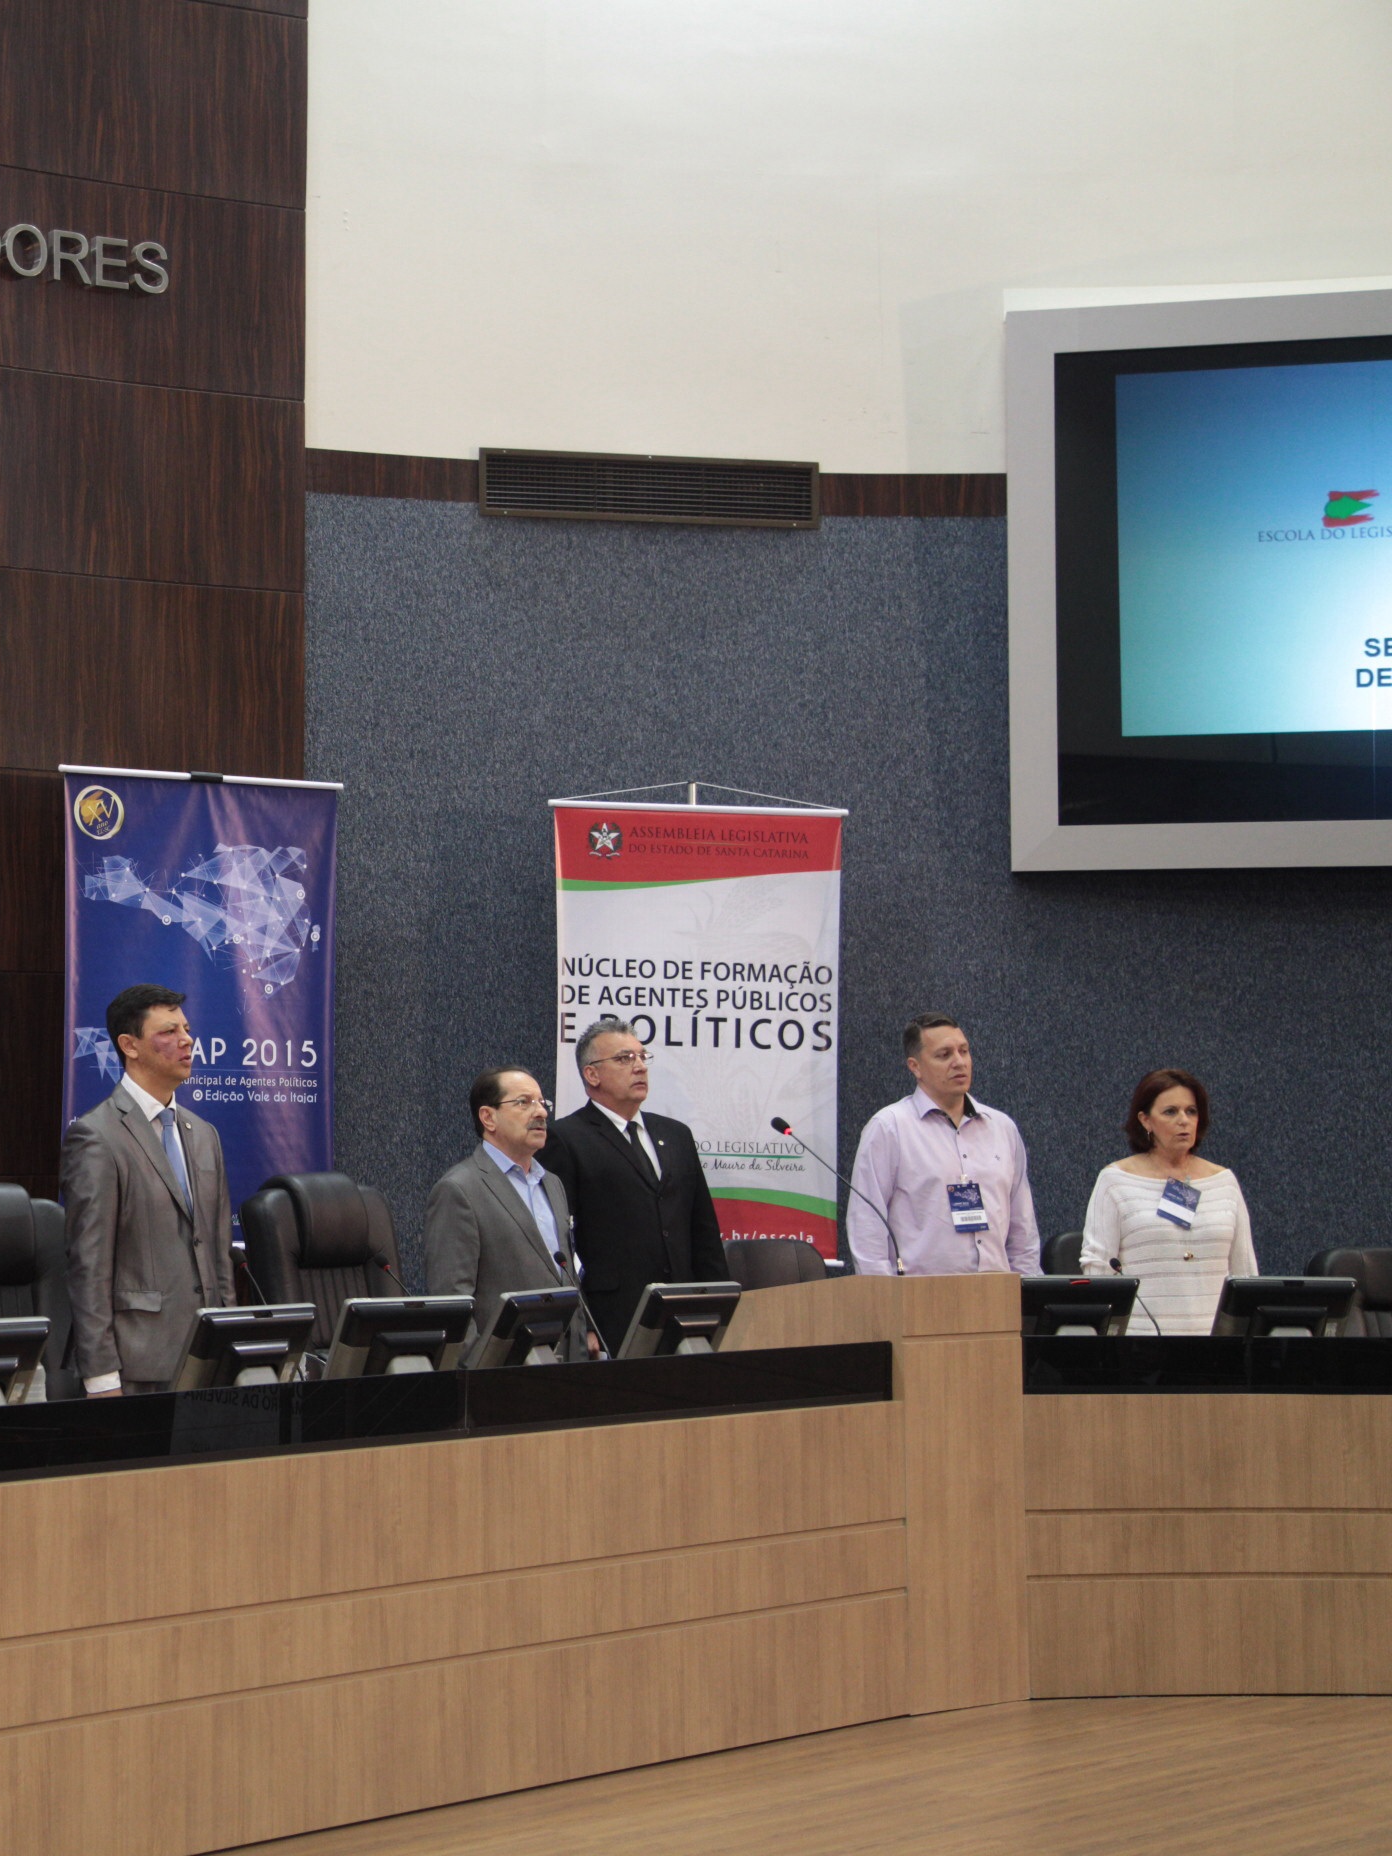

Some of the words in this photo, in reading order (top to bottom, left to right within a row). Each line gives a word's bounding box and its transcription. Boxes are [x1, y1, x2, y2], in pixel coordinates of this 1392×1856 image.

[1257, 528, 1316, 543] ESCOLA
[1320, 526, 1346, 541] DO
[1355, 667, 1392, 688] DE
[629, 826, 715, 842] ASSEMBLEIA
[720, 828, 809, 845] LEGISLATIVA
[628, 843, 647, 854] DO
[650, 844, 694, 856] ESTADO
[696, 845, 712, 857] DE
[714, 846, 750, 858] SANTA
[752, 848, 809, 860] CATARINA
[561, 953, 657, 979] NÚCLEO
[663, 960, 694, 981] DE
[700, 961, 834, 990] FORMAÇÃO
[561, 984, 591, 1005] DE
[597, 985, 709, 1009] AGENTES
[716, 986, 833, 1014] PÚBLICOS
[560, 1012, 578, 1044] E
[599, 1009, 834, 1052] OLÍTICOS
[242, 1038, 318, 1068] 2015
[225, 1076, 237, 1086] de
[239, 1076, 276, 1089] Agentes
[279, 1077, 318, 1088] Políticos
[205, 1090, 245, 1104] Edição
[247, 1091, 271, 1102] Vale
[273, 1091, 287, 1103] do
[290, 1092, 318, 1105] Itajaí
[717, 1141, 805, 1155] LEGISLATIVO
[711, 1158, 746, 1171] Mauro
[748, 1158, 762, 1170] da
[765, 1158, 806, 1172] Silveira
